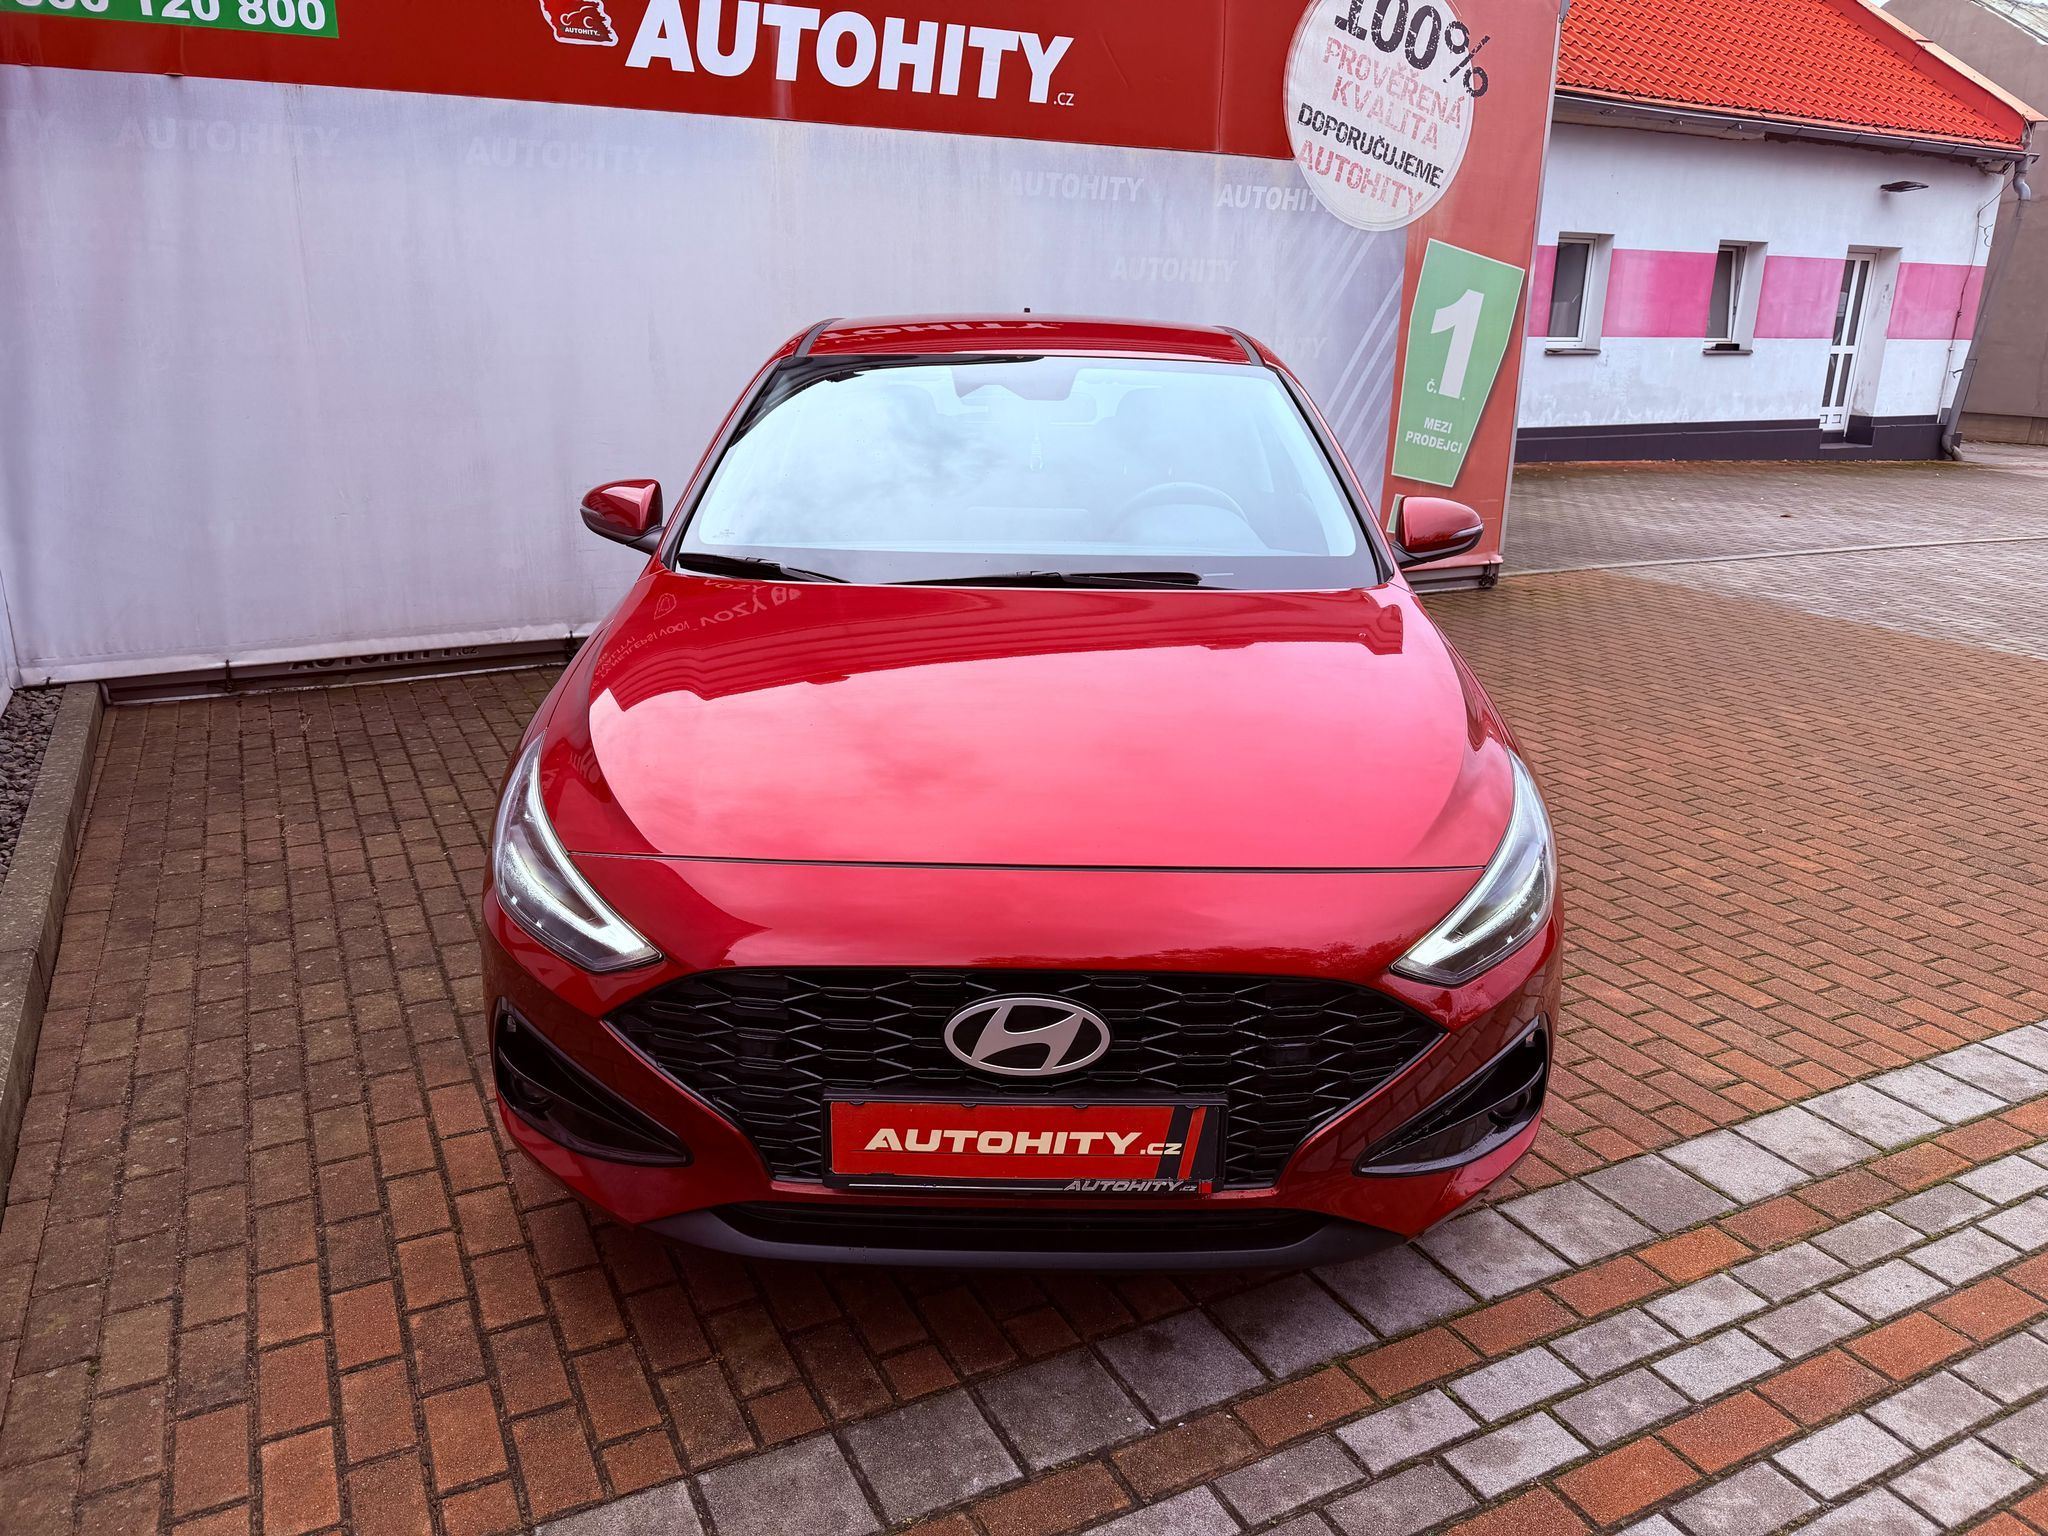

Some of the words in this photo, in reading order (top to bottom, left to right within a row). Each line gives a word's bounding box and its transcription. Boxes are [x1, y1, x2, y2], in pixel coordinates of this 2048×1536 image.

[238, 0, 326, 30] 800
[1334, 0, 1490, 97] 100%
[1331, 75, 1439, 150] KVALITA
[1297, 102, 1444, 188] DOPORUČUJEME
[1007, 170, 1144, 202] AUTOHITY
[1296, 140, 1424, 215] AUTOHITY
[1216, 183, 1331, 214] AUTOHIT
[1110, 256, 1238, 284] AUTOHITY
[1424, 417, 1453, 433] MEZI
[1405, 431, 1462, 454] PRODEJCI
